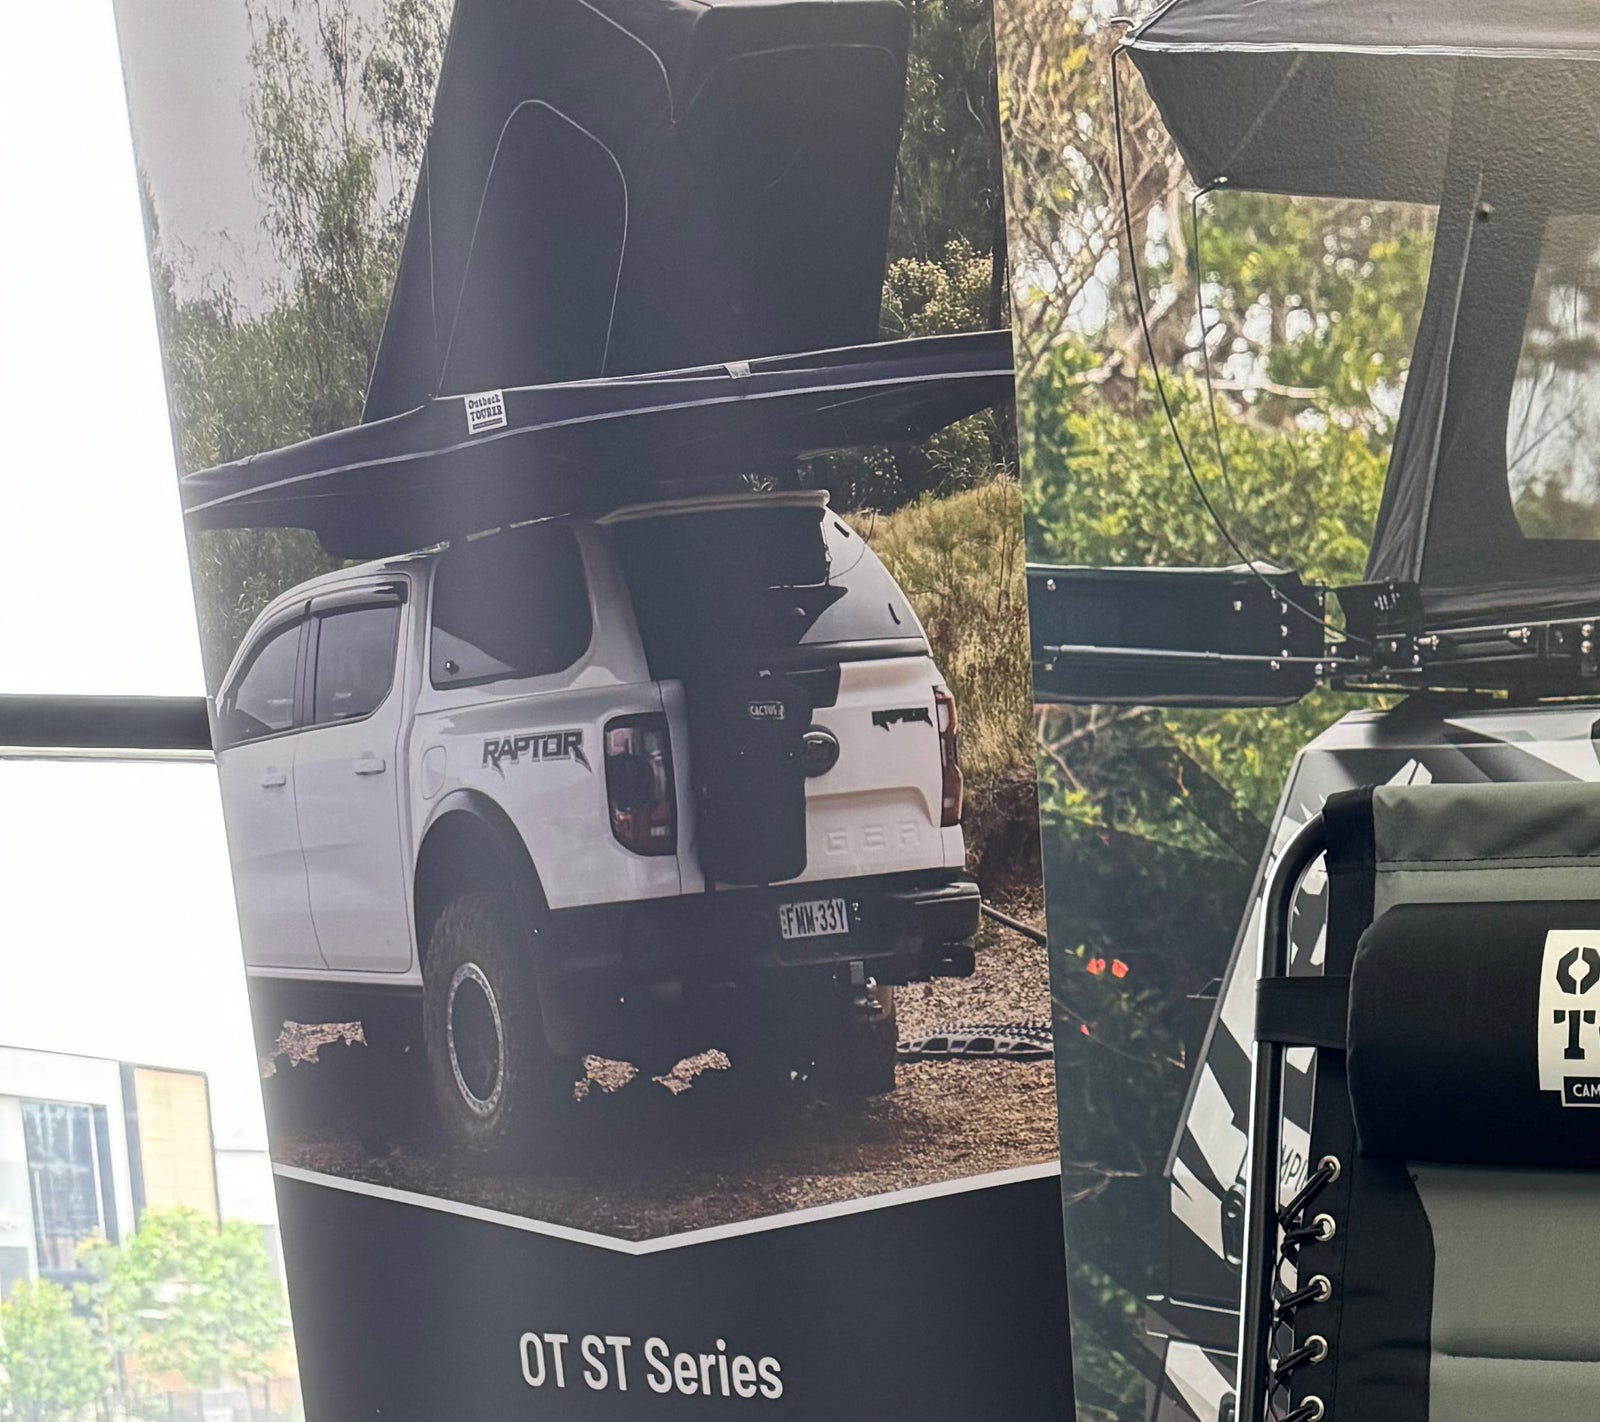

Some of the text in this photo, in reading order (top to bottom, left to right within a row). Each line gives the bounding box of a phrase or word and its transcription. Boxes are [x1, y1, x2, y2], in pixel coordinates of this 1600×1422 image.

[482, 729, 592, 779] RAPTOR
[519, 1332, 783, 1399] OT ST Series
